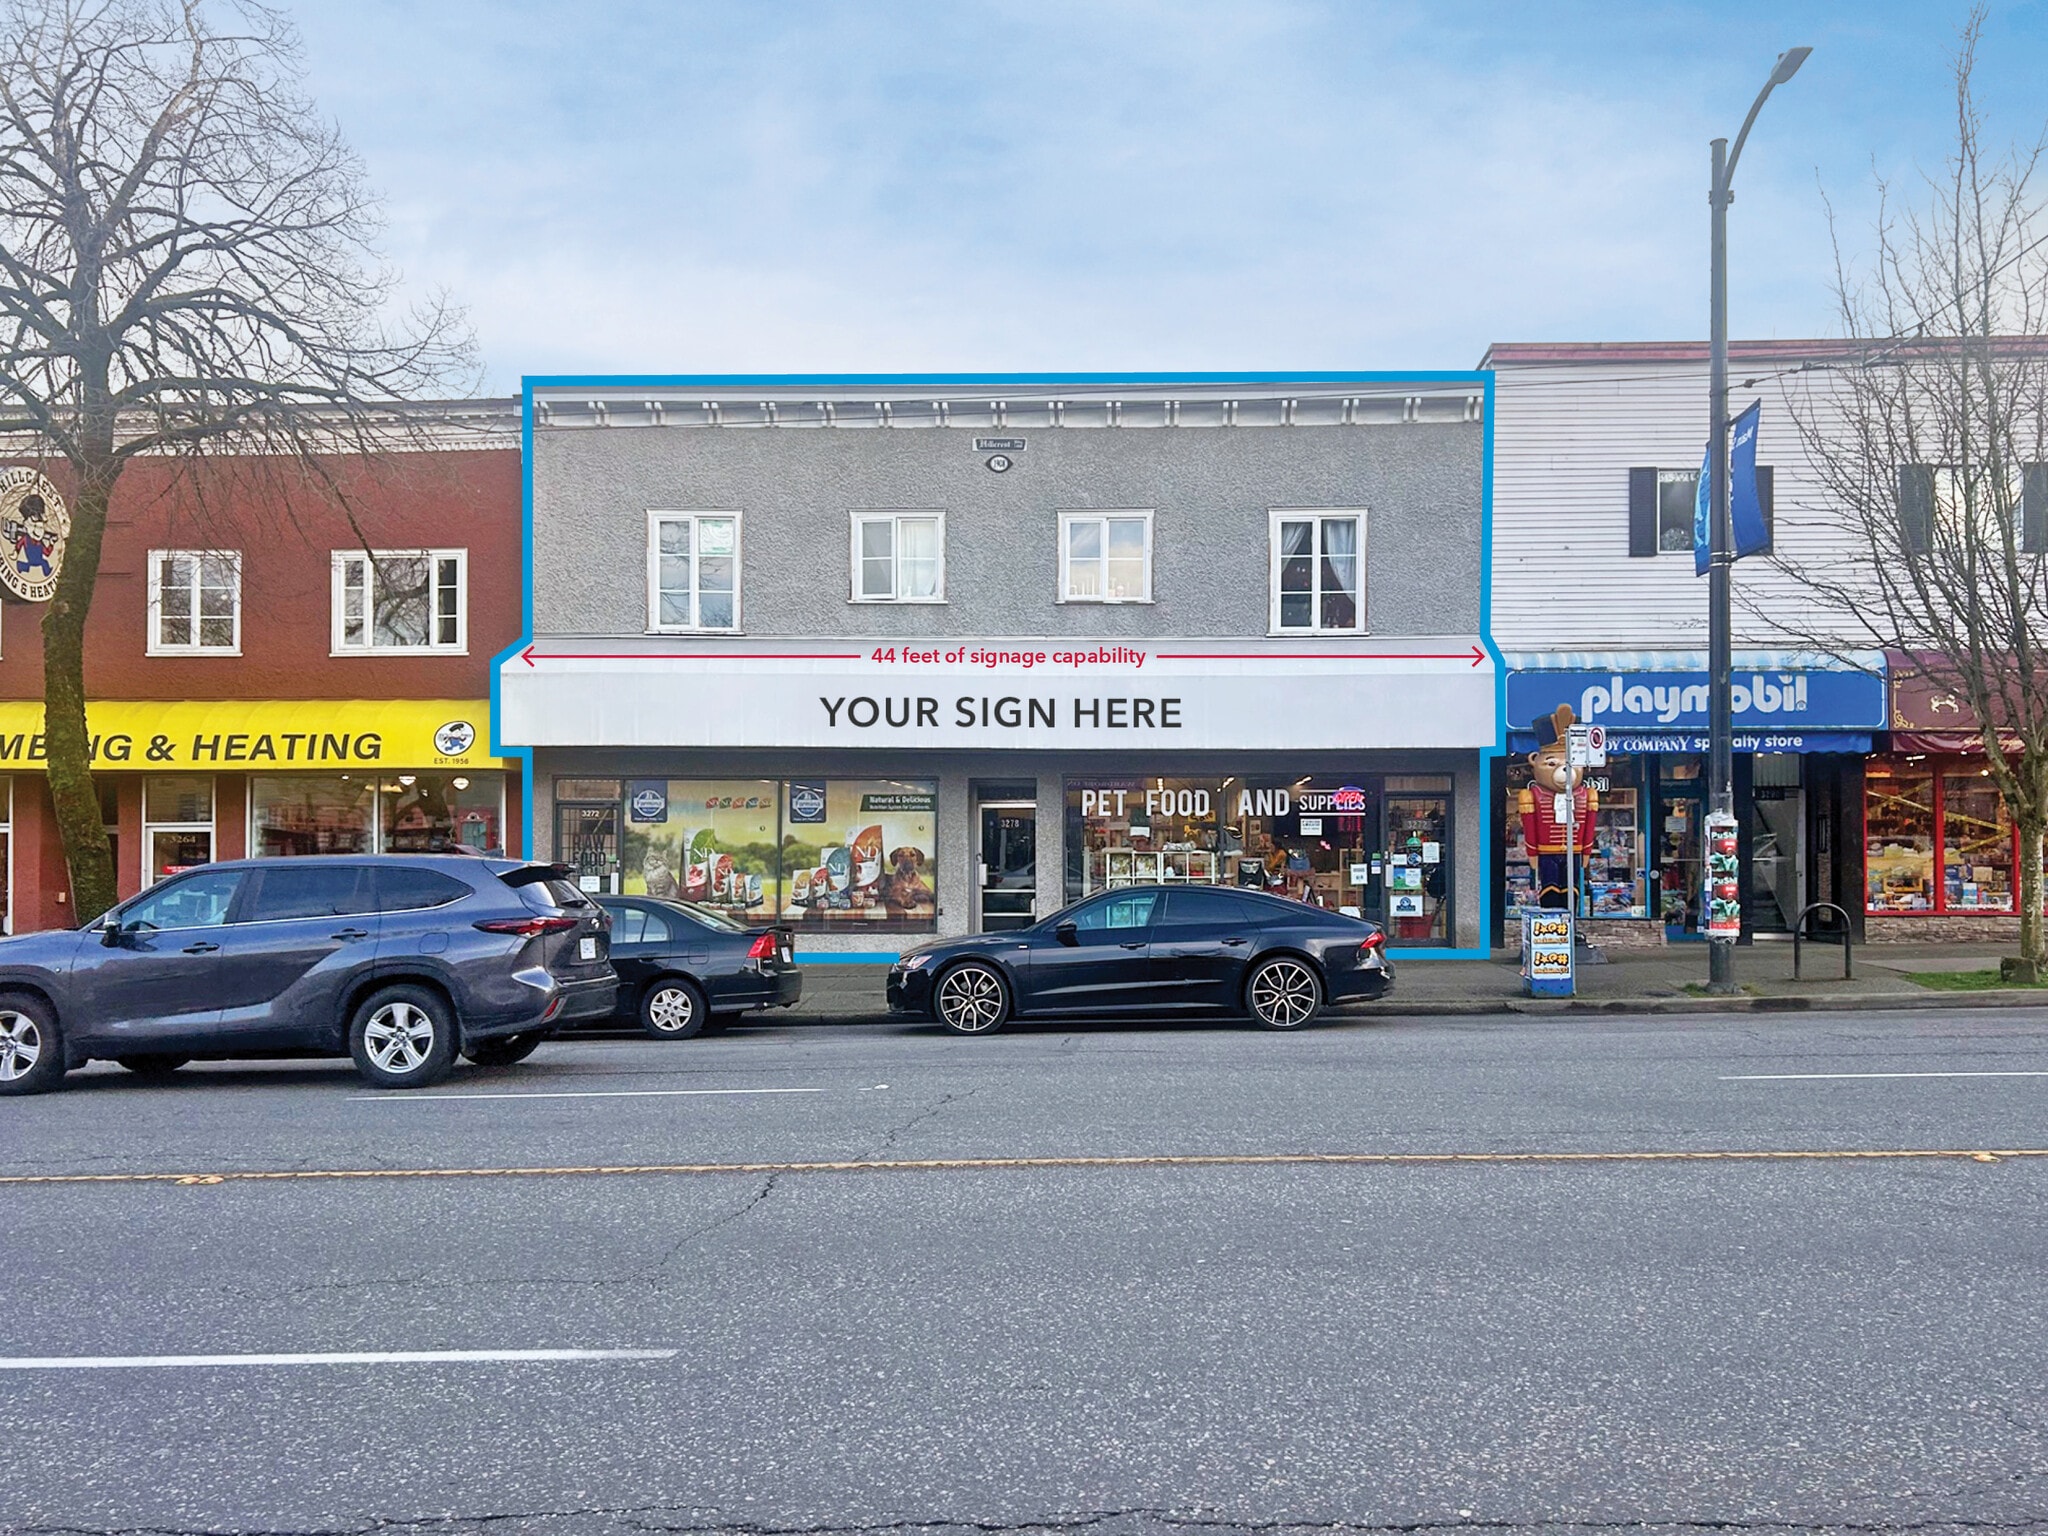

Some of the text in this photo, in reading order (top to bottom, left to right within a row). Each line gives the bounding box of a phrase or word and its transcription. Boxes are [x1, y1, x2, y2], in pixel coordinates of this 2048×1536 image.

[0, 471, 62, 507] HILLCEST
[145, 734, 175, 761] &
[191, 732, 382, 761] HEATING
[1623, 736, 1691, 752] COMPANY
[1693, 734, 1761, 751] spalty
[1764, 735, 1803, 747] store
[433, 757, 450, 765] EST.
[1081, 789, 1128, 817] PET
[1146, 789, 1210, 817] FOOD
[1238, 789, 1290, 817] AND
[581, 809, 600, 818] 3272
[1001, 819, 1020, 828] 3278
[573, 851, 606, 866] FOOD
